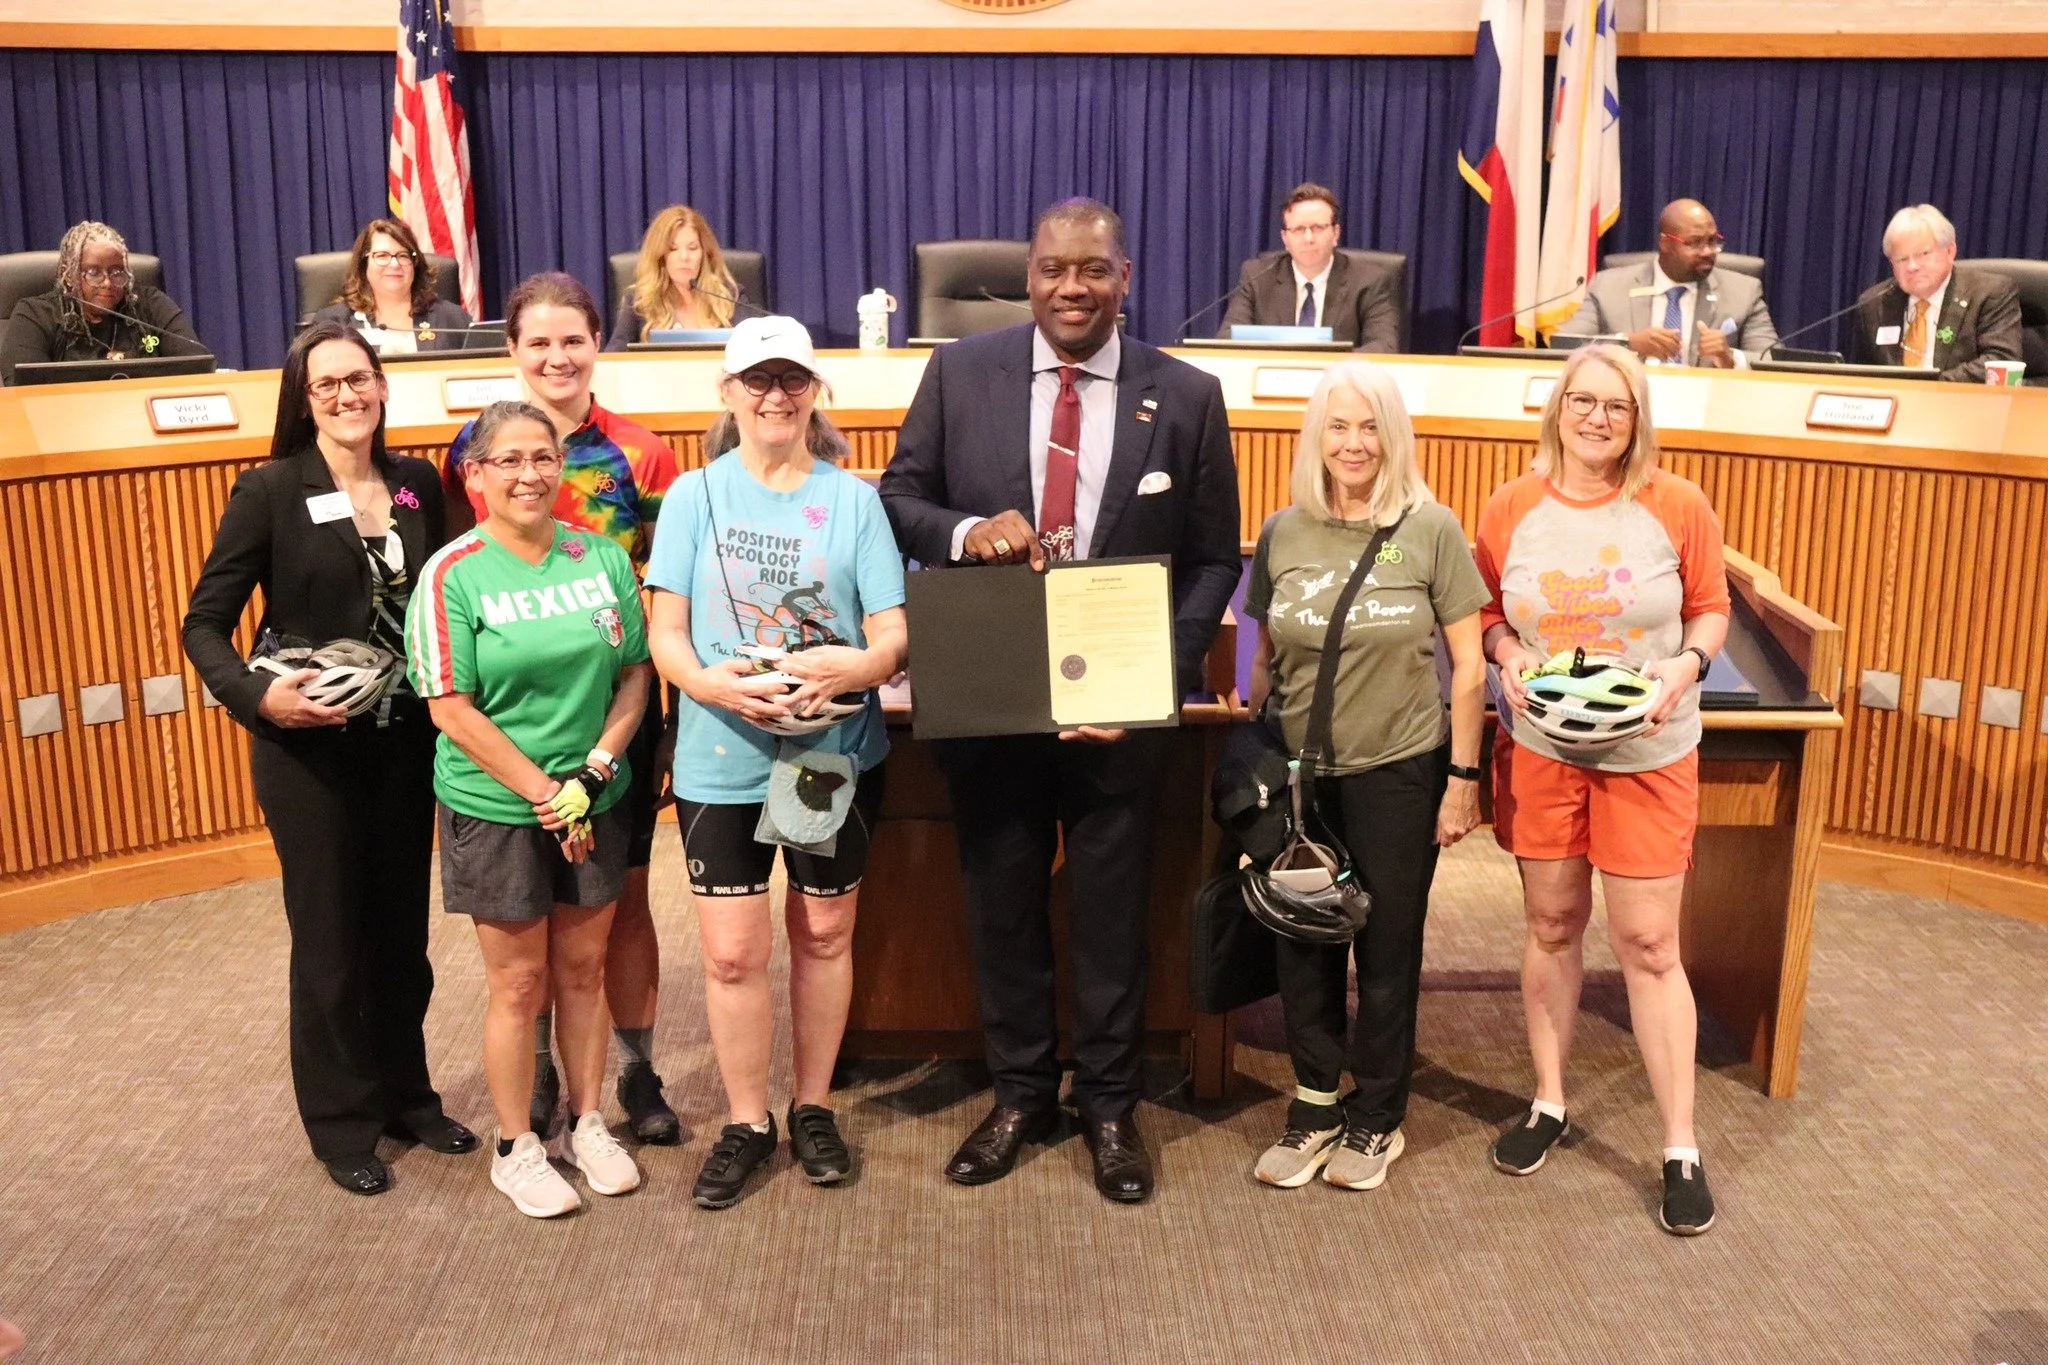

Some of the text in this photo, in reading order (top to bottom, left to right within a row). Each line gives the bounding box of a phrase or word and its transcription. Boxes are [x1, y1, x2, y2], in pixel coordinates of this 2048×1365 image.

[174, 403, 207, 413] Vicki
[178, 414, 209, 424] Byrd
[727, 528, 802, 552] POSITIVE
[716, 543, 800, 569] CYCOLOGY
[760, 567, 799, 586] RIDE
[1294, 607, 1330, 626] The
[1364, 599, 1416, 620] Room
[710, 641, 730, 656] The
